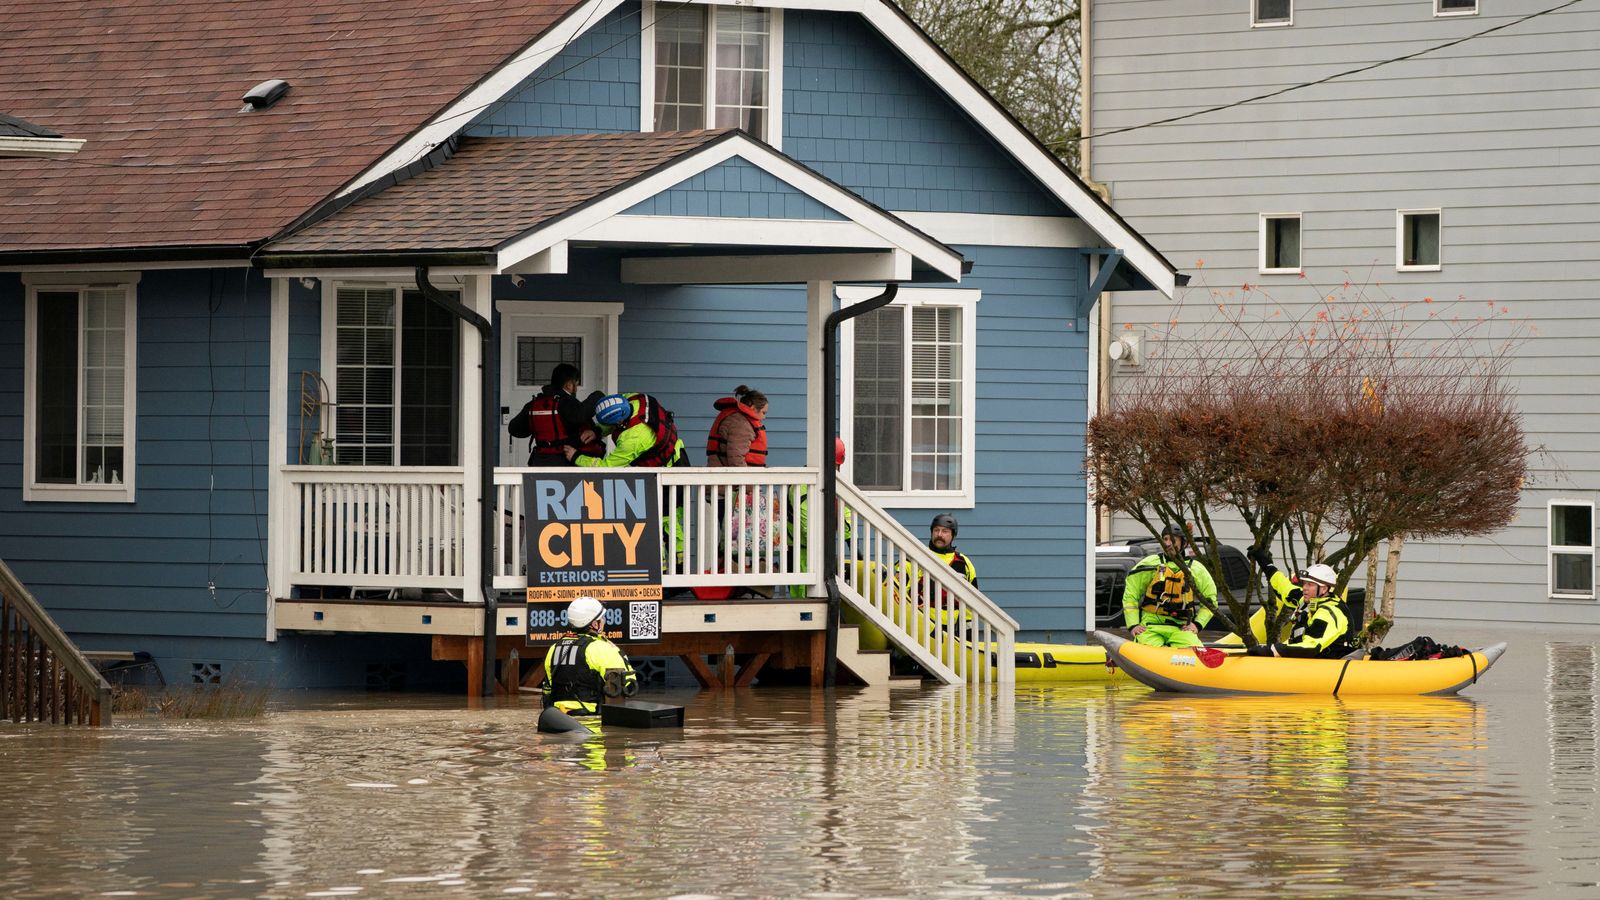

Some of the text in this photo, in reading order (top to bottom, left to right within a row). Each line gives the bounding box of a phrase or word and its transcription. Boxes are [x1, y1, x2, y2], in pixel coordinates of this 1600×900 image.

[535, 479, 647, 520] RAIN
[538, 522, 647, 568] CITY
[540, 570, 605, 583] EXTERIORS
[528, 588, 661, 599] ROOFING SIDING PAINTING WINDOWS DECKS
